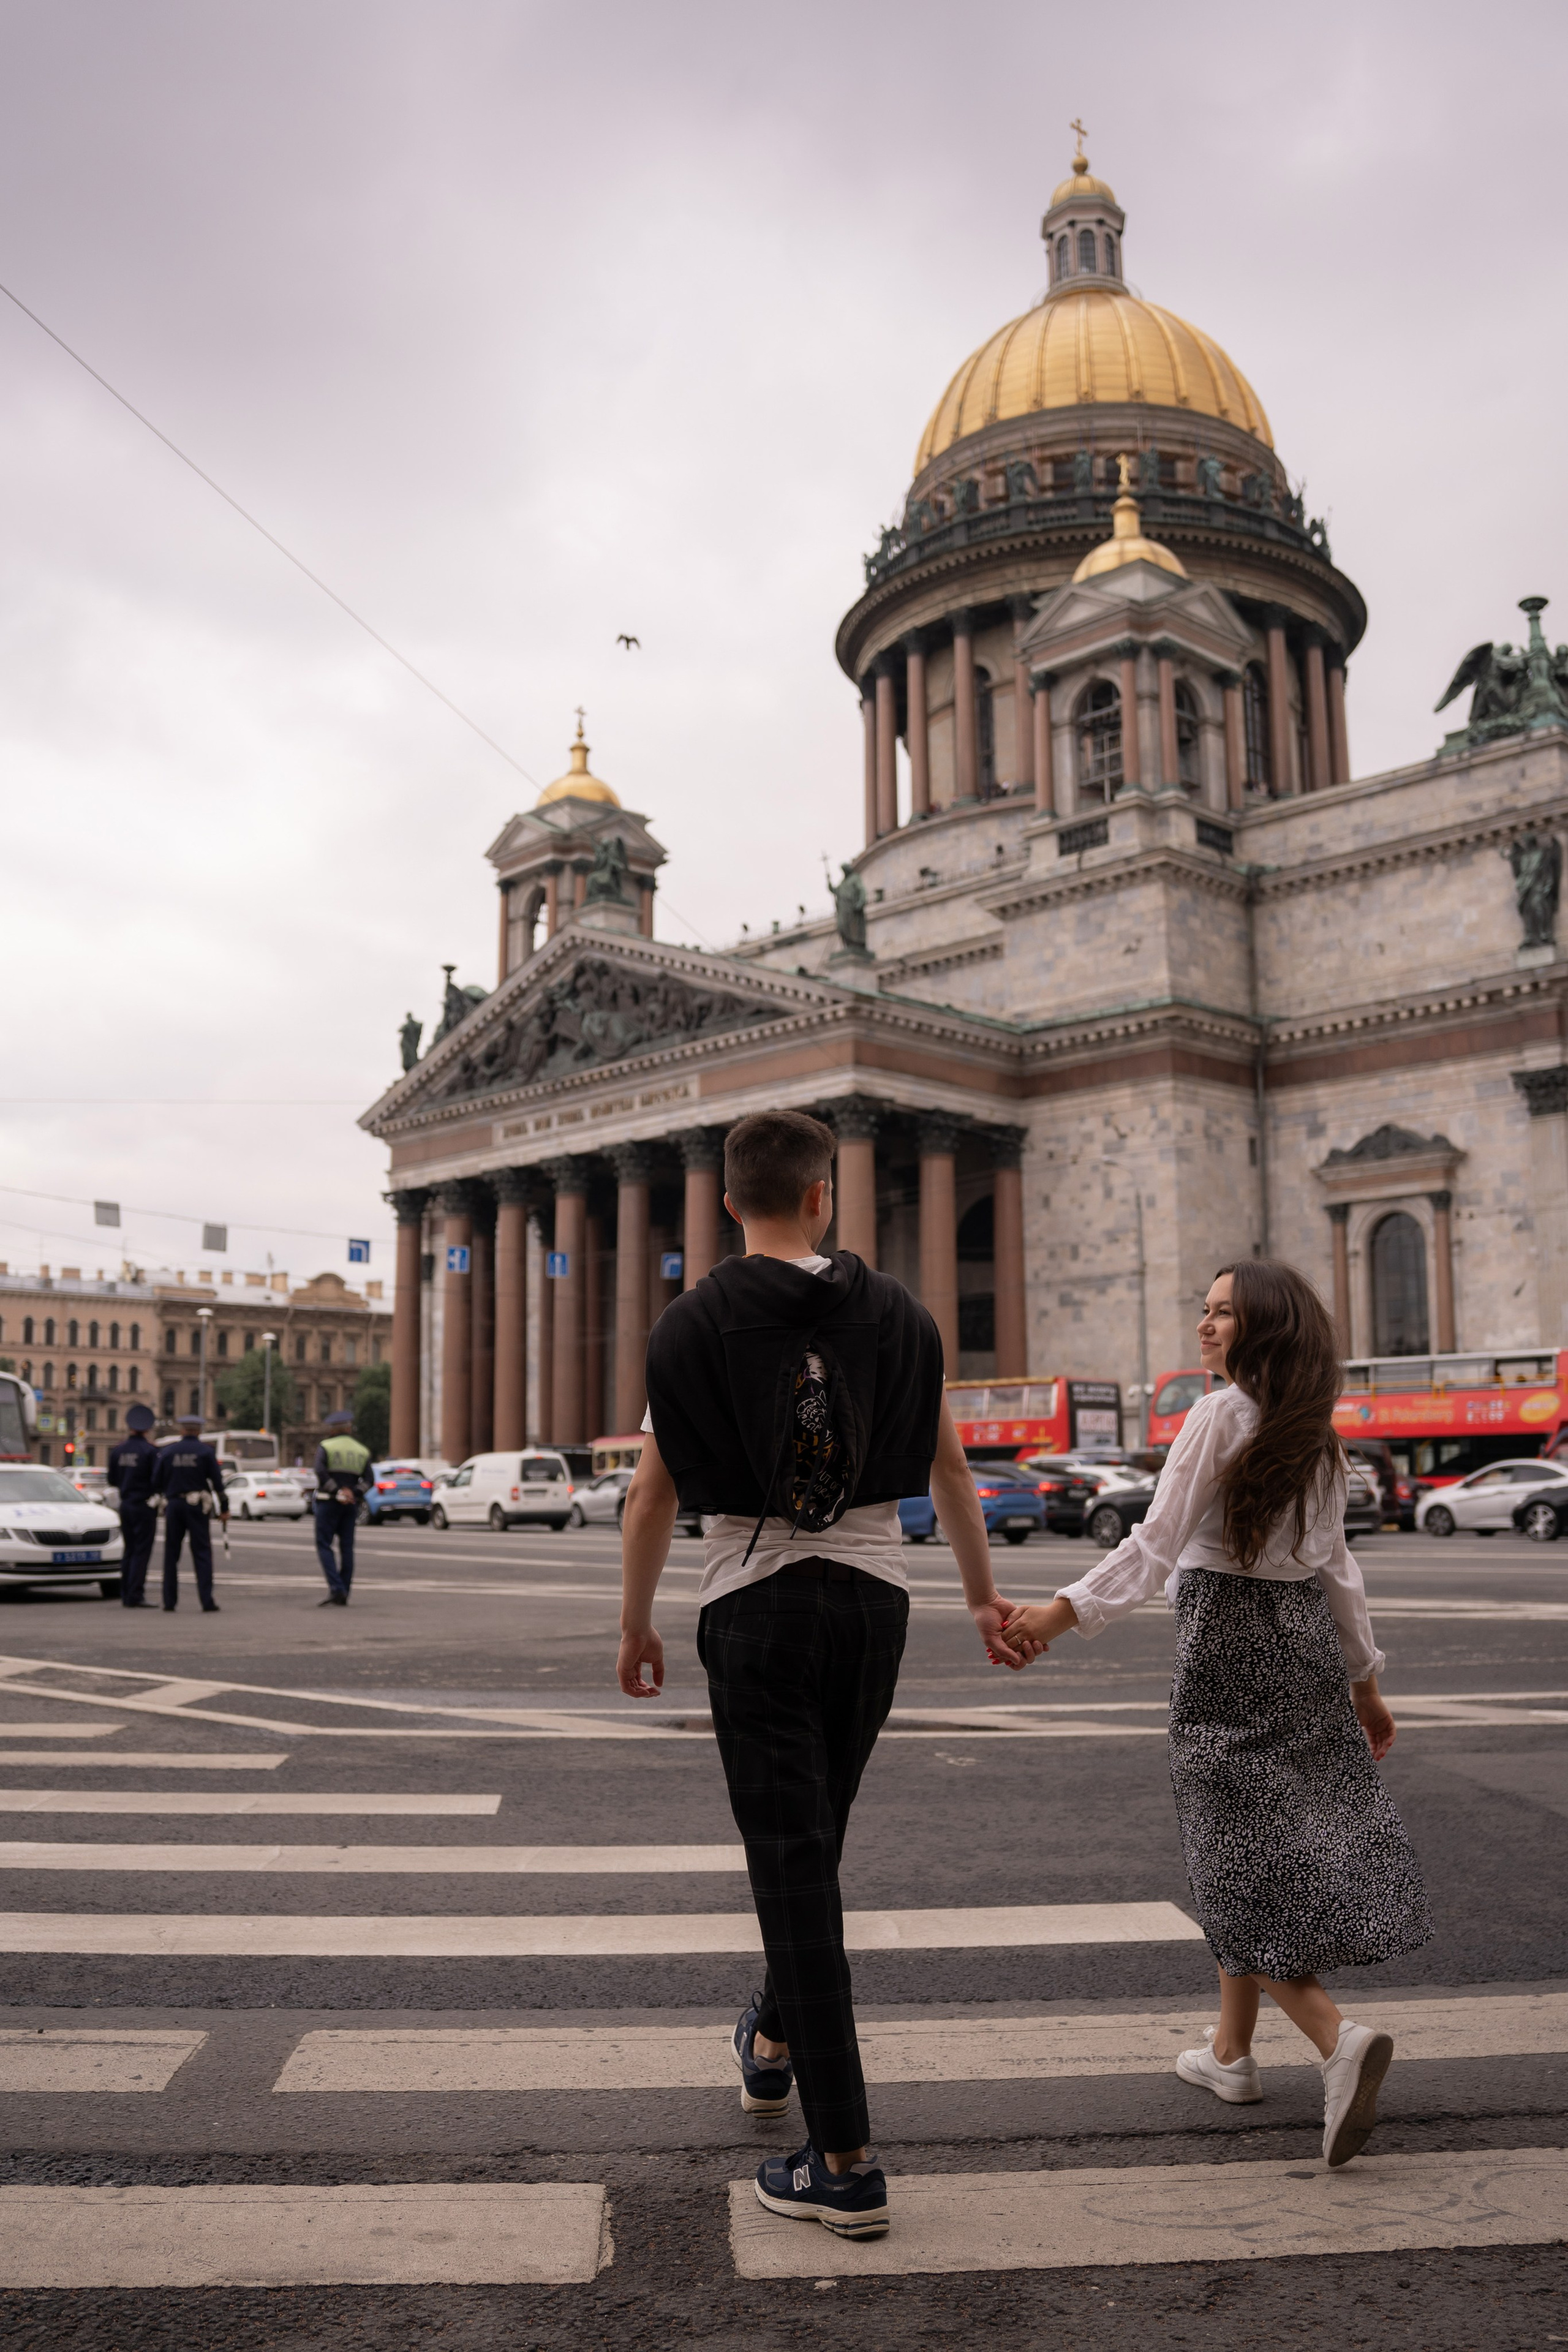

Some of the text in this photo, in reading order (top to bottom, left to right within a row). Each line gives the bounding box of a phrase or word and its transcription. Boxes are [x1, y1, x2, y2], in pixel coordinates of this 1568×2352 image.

[817, 1471, 832, 1484] UT
[813, 1483, 832, 1502] ORK
[793, 2164, 811, 2192] N
